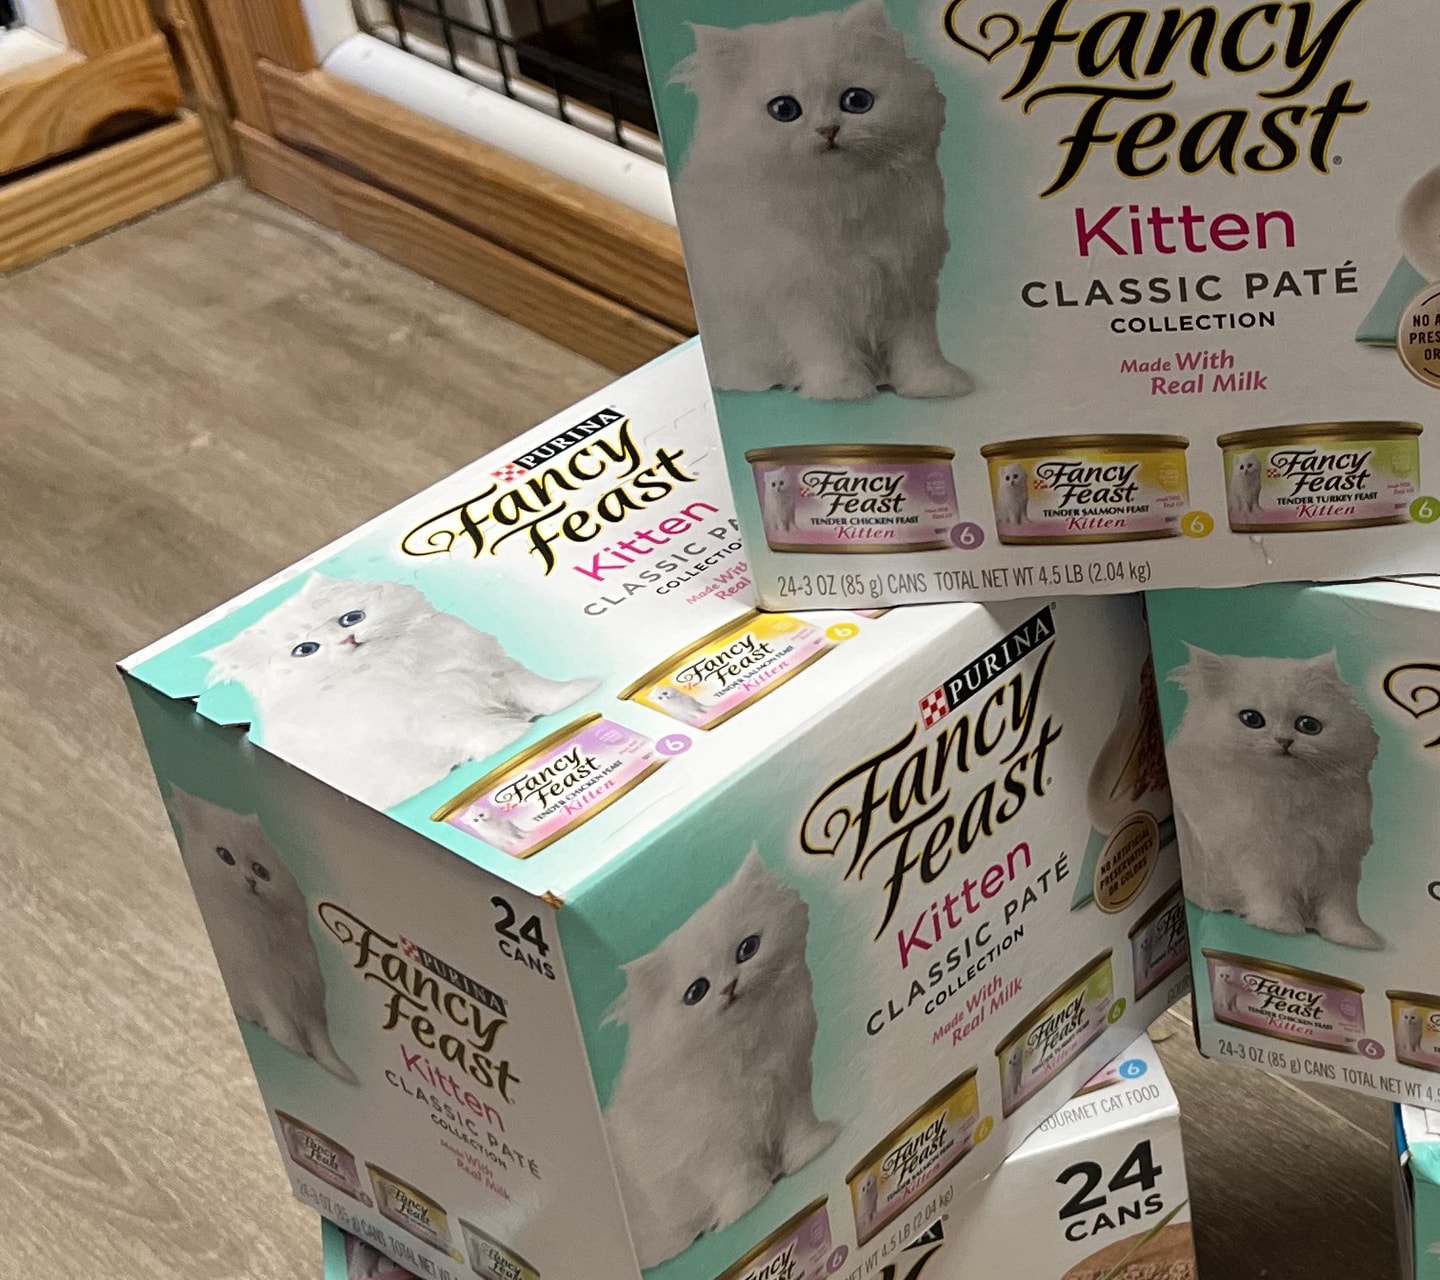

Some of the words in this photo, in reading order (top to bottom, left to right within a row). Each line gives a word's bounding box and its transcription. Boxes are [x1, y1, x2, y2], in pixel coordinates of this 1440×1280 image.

[1022, 79, 1371, 199] Feast
[1074, 205, 1296, 257] Kitten
[1021, 274, 1223, 308] CLASSIC
[1245, 260, 1359, 299] PATÉ
[1110, 311, 1275, 333] COLLECTION
[1412, 314, 1430, 327] NO
[1120, 357, 1172, 373] Made
[1175, 350, 1235, 371] With
[1424, 348, 1440, 360] OR
[1151, 374, 1205, 396] Real
[1212, 371, 1268, 393] Milk
[523, 410, 618, 469] PURINA
[801, 470, 904, 496] Fancy
[1035, 461, 1139, 487] Fancy
[1270, 449, 1372, 476] Fancy
[1295, 470, 1372, 494] Feast
[401, 418, 640, 559] Fancy
[826, 491, 907, 516] Feast
[1058, 483, 1137, 508] Feast
[1276, 494, 1315, 505] TENDER
[1316, 493, 1353, 503] TURKEY
[1354, 492, 1378, 501] FEAST
[1296, 503, 1356, 518] Kitten
[1418, 501, 1434, 518] 6
[489, 447, 699, 576] Feast
[810, 517, 850, 527] TENDER
[850, 516, 894, 526] CHICKEN
[896, 515, 918, 524] FEAST
[834, 524, 896, 540] Kitten
[1042, 507, 1081, 518] TENDER
[1082, 506, 1125, 517] SALMON
[1126, 504, 1150, 514] FEAST
[1065, 517, 1128, 533] Kitten
[1190, 516, 1205, 533] 6
[572, 501, 720, 582] Kitten
[959, 527, 975, 544] 6
[583, 542, 707, 618] CLASSIC
[656, 538, 742, 596] COLLECTIO
[777, 573, 814, 597] 24-3
[816, 574, 837, 596] OZ
[841, 571, 865, 596] (85
[869, 571, 883, 596] g)
[887, 572, 926, 594] CANS
[934, 568, 978, 591] TOTAL
[982, 567, 1010, 589] NET
[1012, 566, 1034, 587] WT
[1038, 565, 1060, 585] 4.5
[1066, 564, 1085, 584] LB
[1087, 562, 1125, 584] (2.04
[1128, 561, 1151, 582] kg)
[685, 582, 720, 606] Made
[718, 577, 752, 602] Real
[949, 617, 1051, 706] PURINA
[800, 640, 1056, 881] Fancy
[859, 715, 1063, 942] Feast
[490, 895, 550, 957] 24
[896, 840, 1032, 970] Kitten
[499, 939, 556, 980] CANS
[865, 919, 994, 1037] CLASSIC
[1004, 852, 1071, 926] PATÉ
[318, 902, 508, 1053] Fancy
[421, 949, 505, 1016] PURINA
[924, 924, 1025, 1015] COLLECTION
[932, 1012, 964, 1043] Made
[965, 976, 1003, 1014] With
[951, 1009, 985, 1047] Real
[988, 977, 1024, 1015] Milk
[364, 972, 520, 1104] Feast
[385, 1069, 479, 1137] CLASSIC
[400, 1043, 506, 1133] Kitten
[1100, 1095, 1124, 1113] CAT
[1125, 1084, 1160, 1106] FOOD
[1056, 1139, 1163, 1220] 24
[1064, 1192, 1165, 1243] CANS
